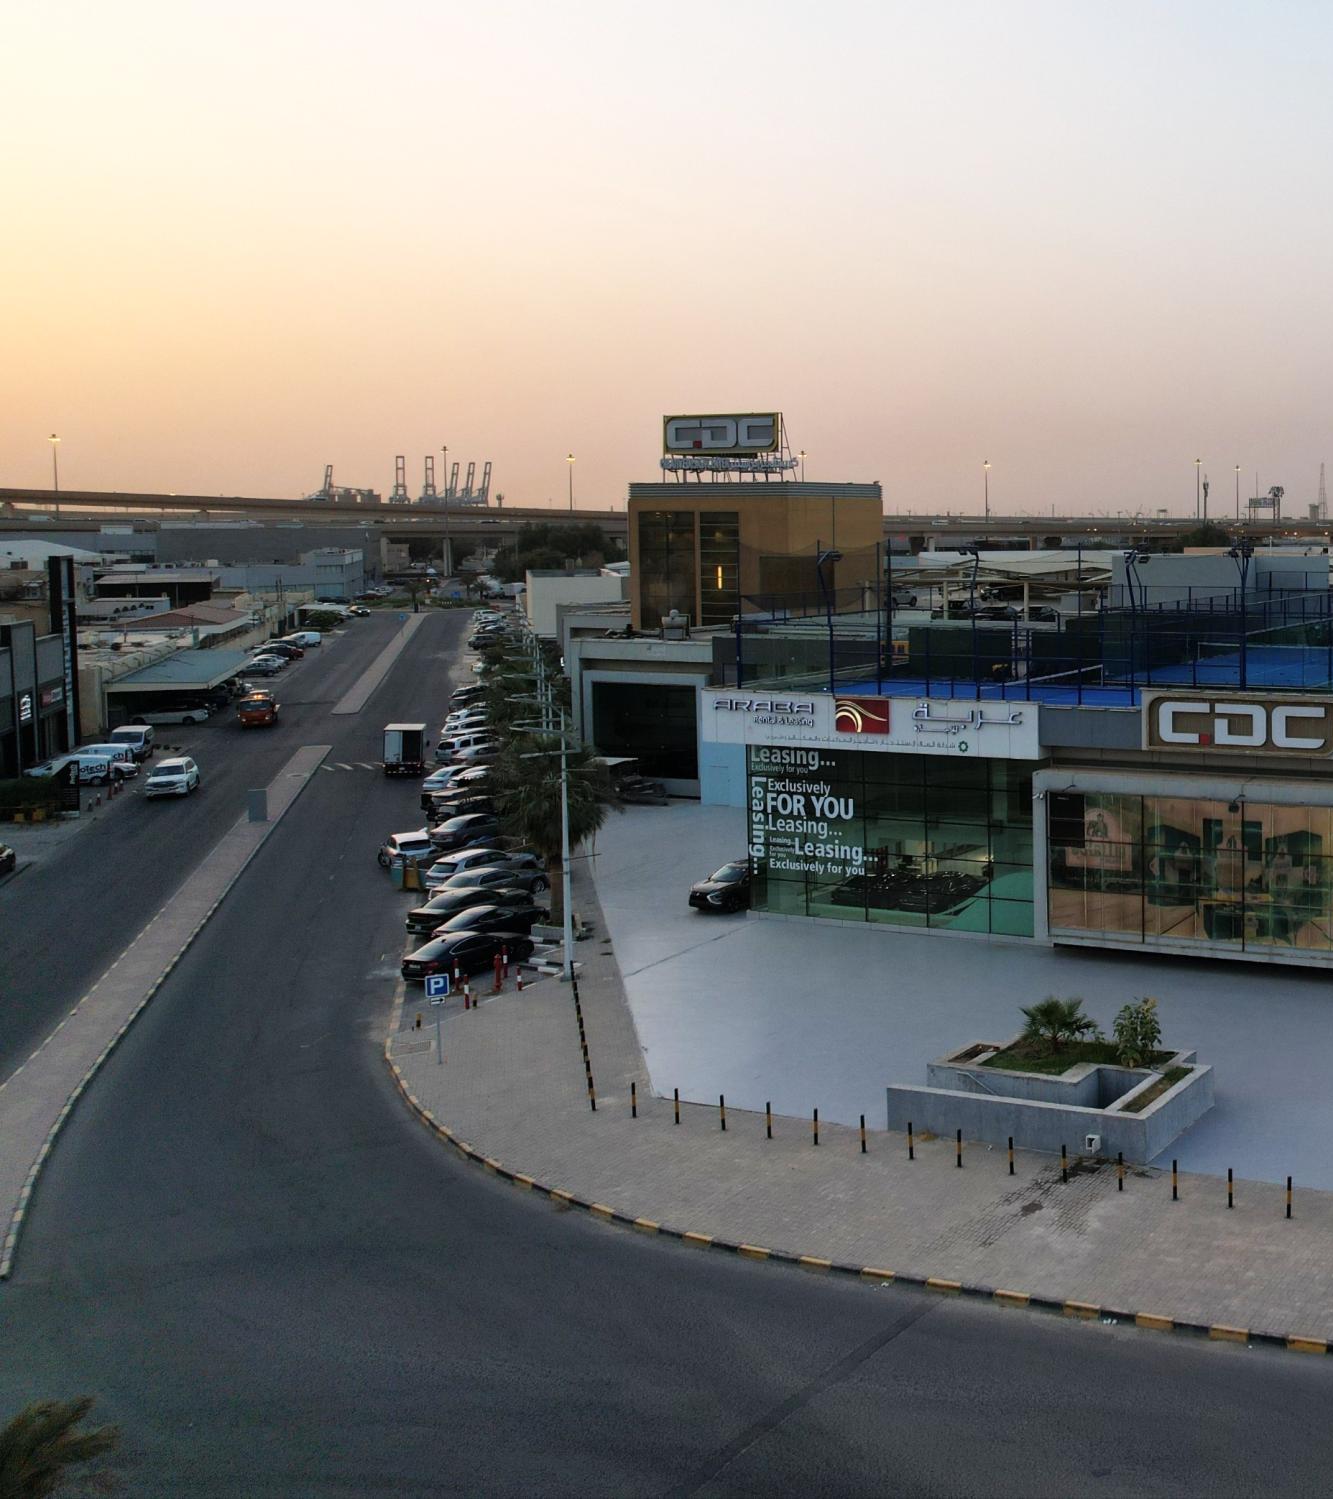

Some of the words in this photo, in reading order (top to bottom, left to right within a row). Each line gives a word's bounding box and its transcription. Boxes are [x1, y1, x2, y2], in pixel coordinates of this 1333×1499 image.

[666, 416, 775, 449] CDC
[713, 699, 814, 714] ARABA
[785, 717, 814, 727] Leasing
[1158, 701, 1326, 749] CDC
[751, 763, 785, 774] Exclusively
[786, 764, 795, 773] for
[796, 766, 809, 775] you
[767, 778, 831, 797] Exclusively
[766, 793, 806, 816] FOR
[812, 795, 854, 820] YOU
[769, 858, 825, 875] Exclusively
[827, 862, 843, 873] for
[845, 866, 865, 877] you
[430, 978, 444, 994] P
